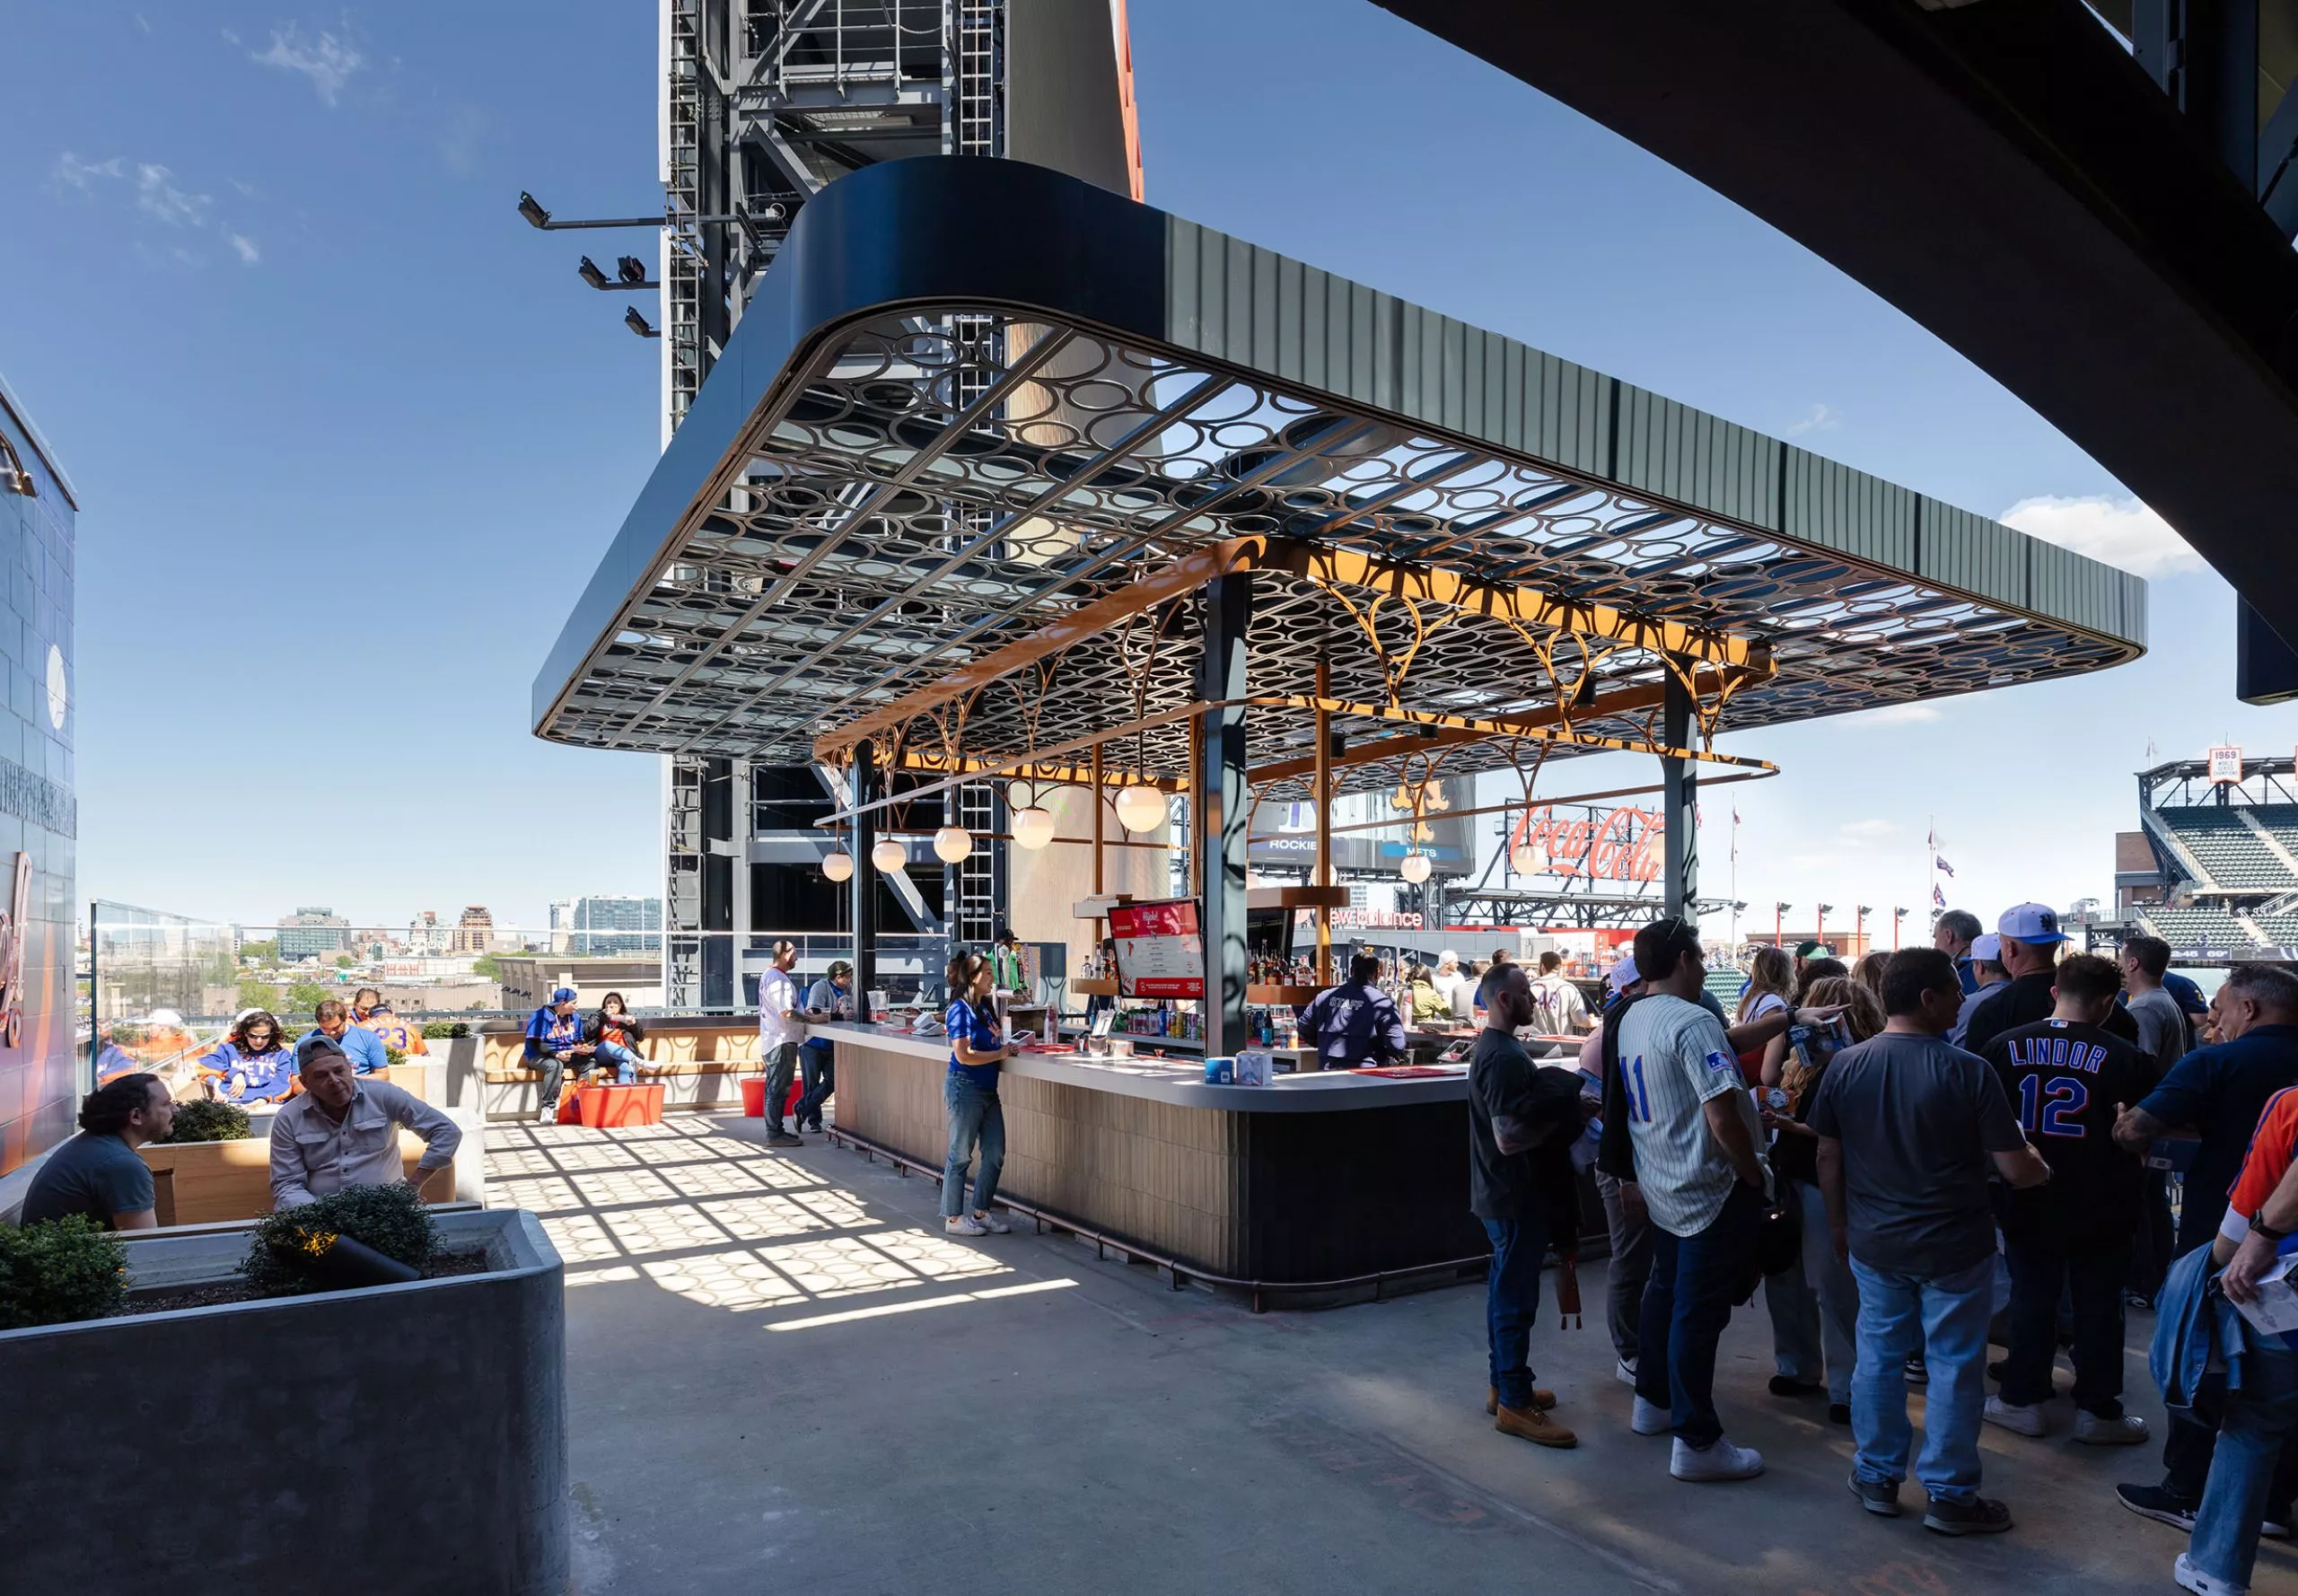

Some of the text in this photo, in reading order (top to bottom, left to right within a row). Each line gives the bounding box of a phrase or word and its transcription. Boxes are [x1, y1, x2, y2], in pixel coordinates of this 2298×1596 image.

[2215, 750, 2237, 759] 1969
[1269, 838, 1317, 851] ROCKIE
[1407, 847, 1437, 857] METS
[1330, 908, 1423, 926] ew balance
[1329, 996, 1364, 1011] STAFF
[2008, 1038, 2108, 1074] LINDOR
[231, 1059, 277, 1078] METS
[2019, 1074, 2090, 1137] 12
